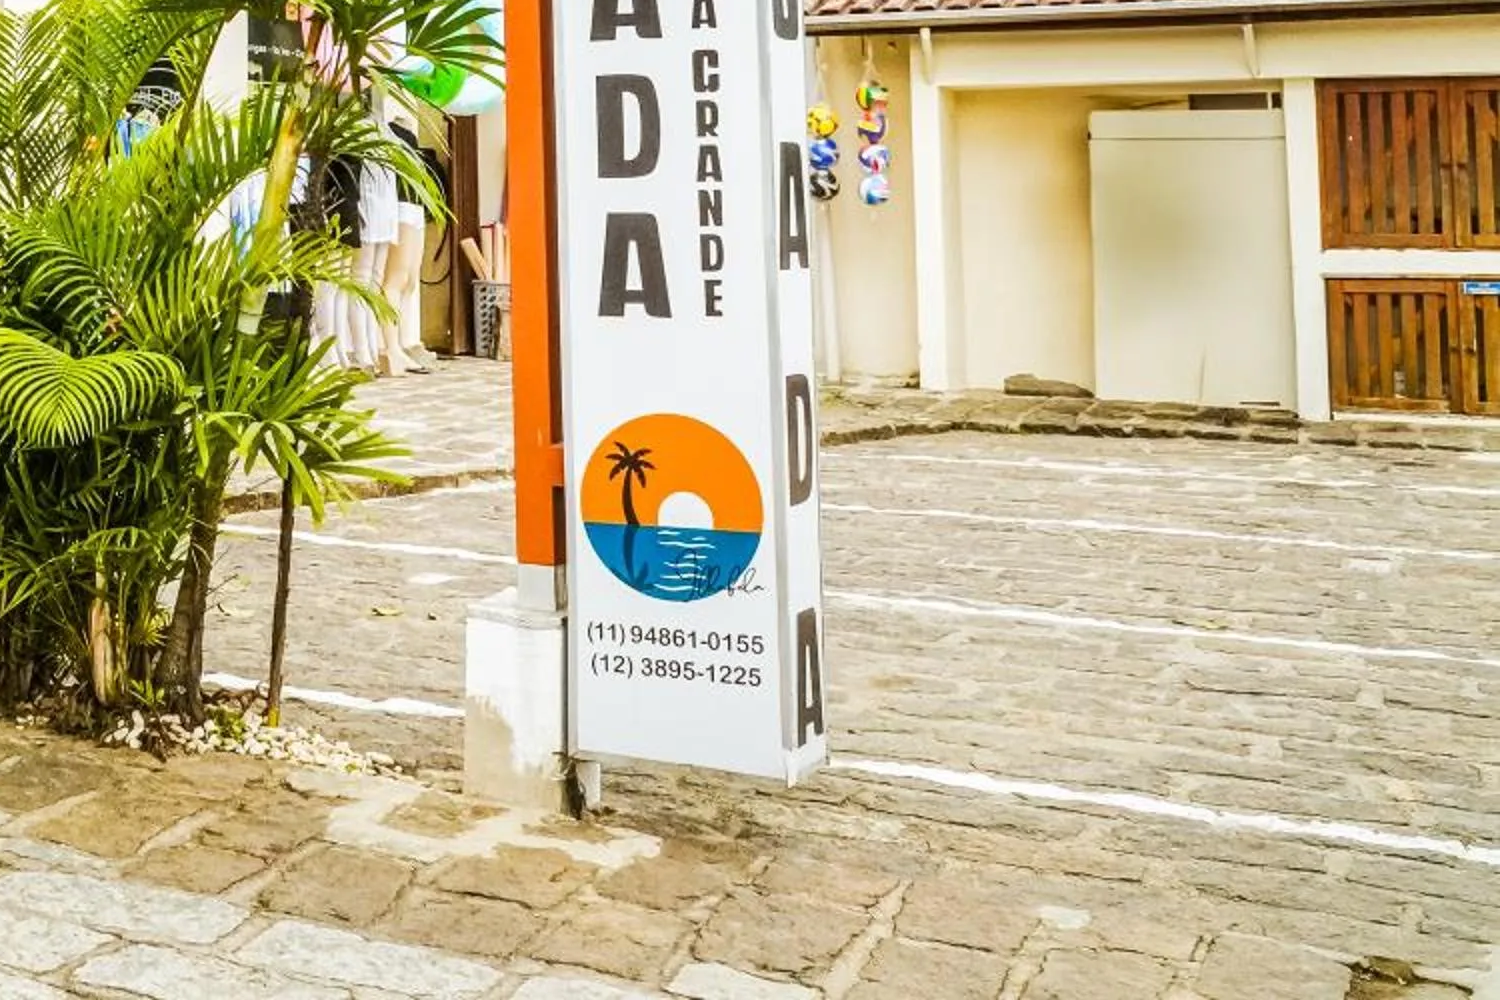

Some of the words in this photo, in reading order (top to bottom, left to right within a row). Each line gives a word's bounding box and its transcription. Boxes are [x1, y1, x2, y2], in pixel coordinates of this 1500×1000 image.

[691, 49, 725, 318] GRANDE
[587, 621, 626, 647] (11)
[630, 625, 765, 655] 94861-0155
[591, 652, 634, 679] (12)
[641, 657, 763, 688] 3895-1225
